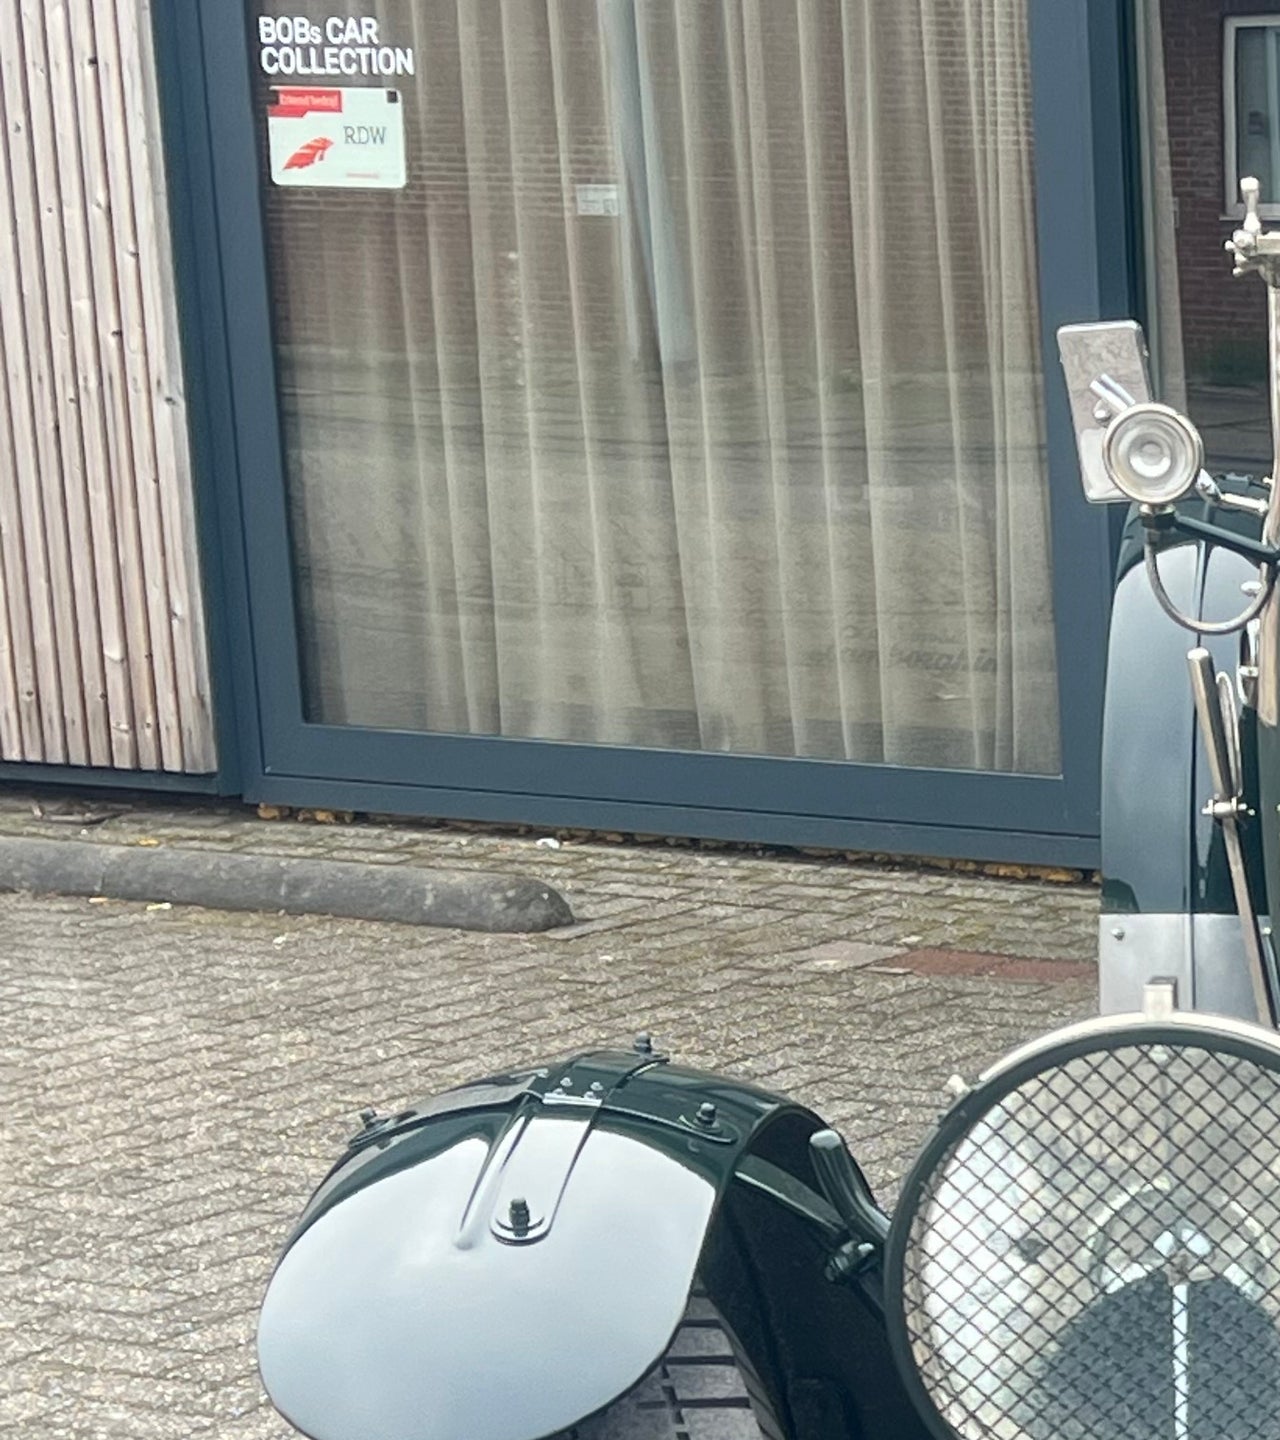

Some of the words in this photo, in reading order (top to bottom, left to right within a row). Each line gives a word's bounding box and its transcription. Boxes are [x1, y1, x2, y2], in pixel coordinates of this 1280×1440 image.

[259, 16, 322, 44] BOBs
[326, 17, 379, 44] CAR
[261, 47, 415, 75] COLLECTION
[344, 126, 386, 144] RDW
